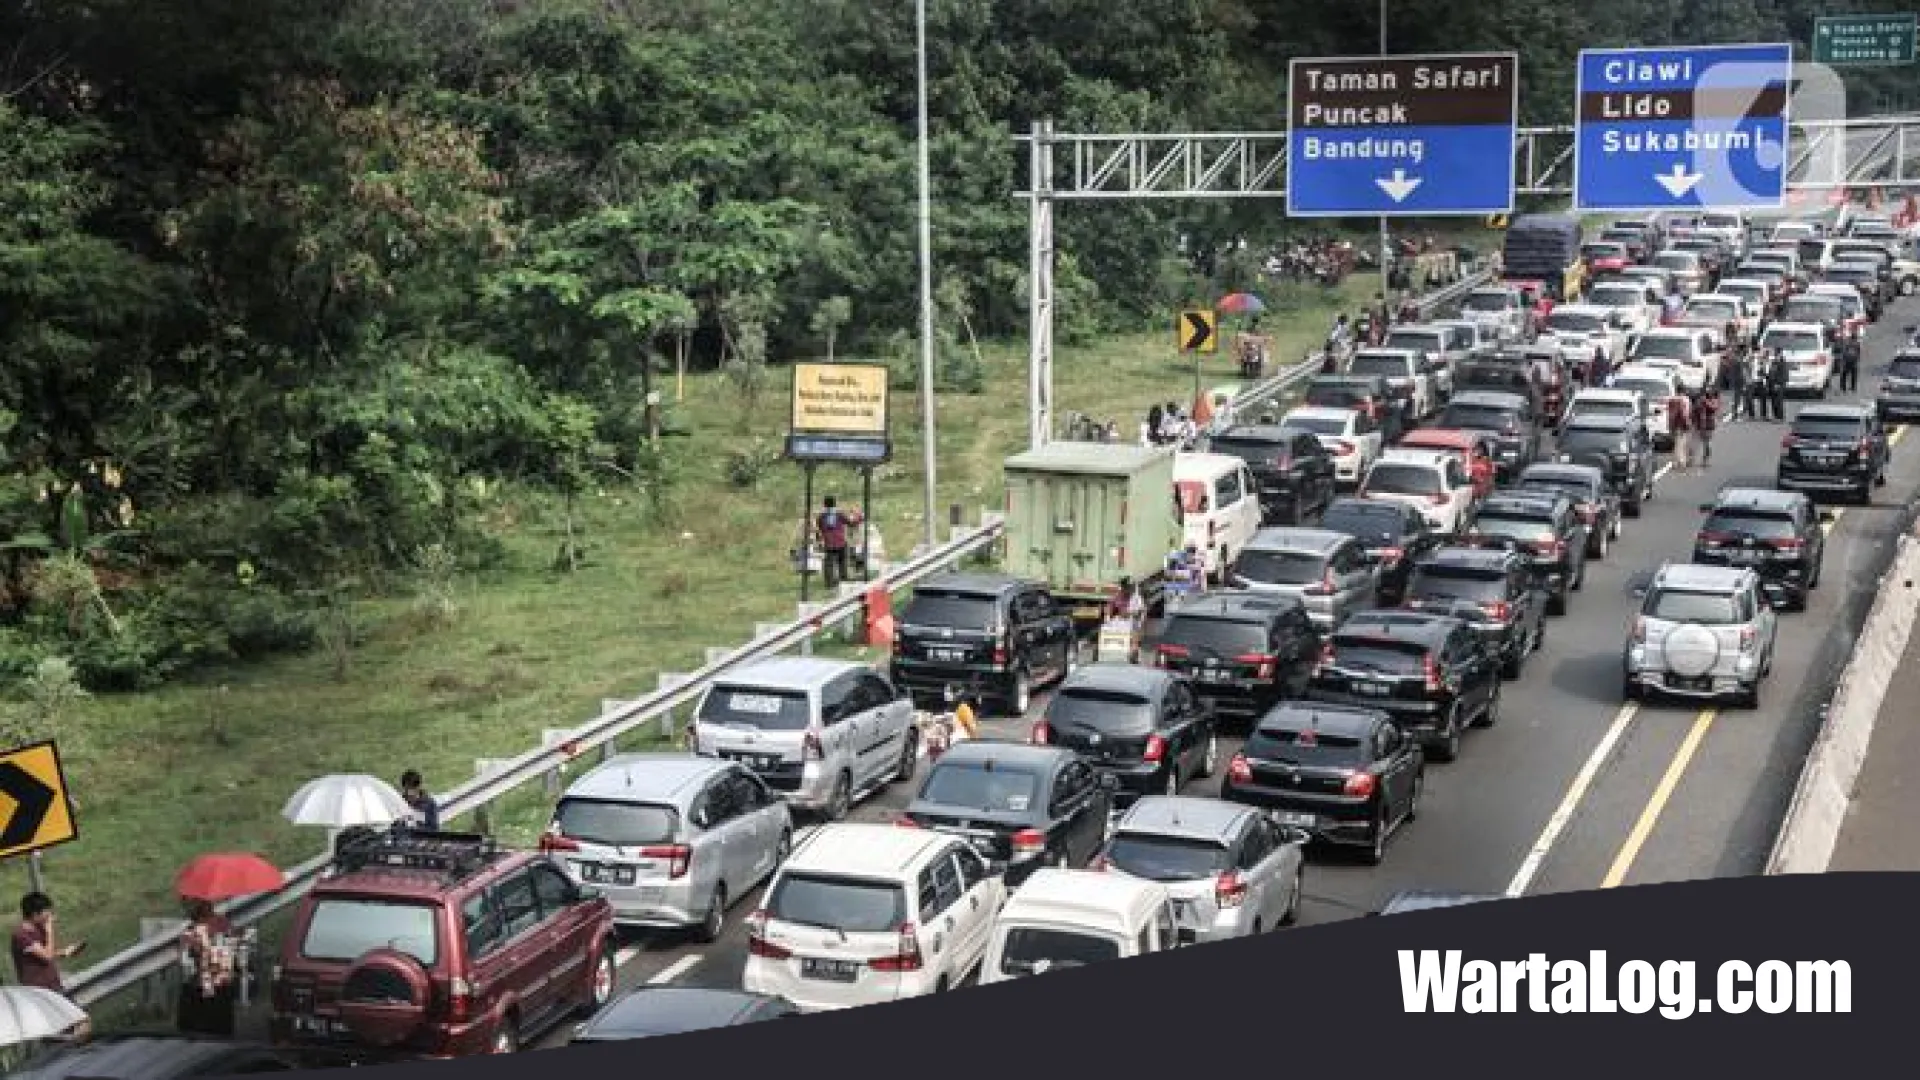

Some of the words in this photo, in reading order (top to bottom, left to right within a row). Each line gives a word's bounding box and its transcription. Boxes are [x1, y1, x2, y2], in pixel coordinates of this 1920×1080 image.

[1305, 70, 1397, 92] Taman
[1414, 64, 1501, 89] Safari
[1605, 57, 1693, 83] Ciawi
[1303, 102, 1409, 125] Puncak
[1603, 94, 1671, 118] Lido
[1303, 136, 1425, 164] Bandung
[1603, 125, 1762, 152] Sukabumi
